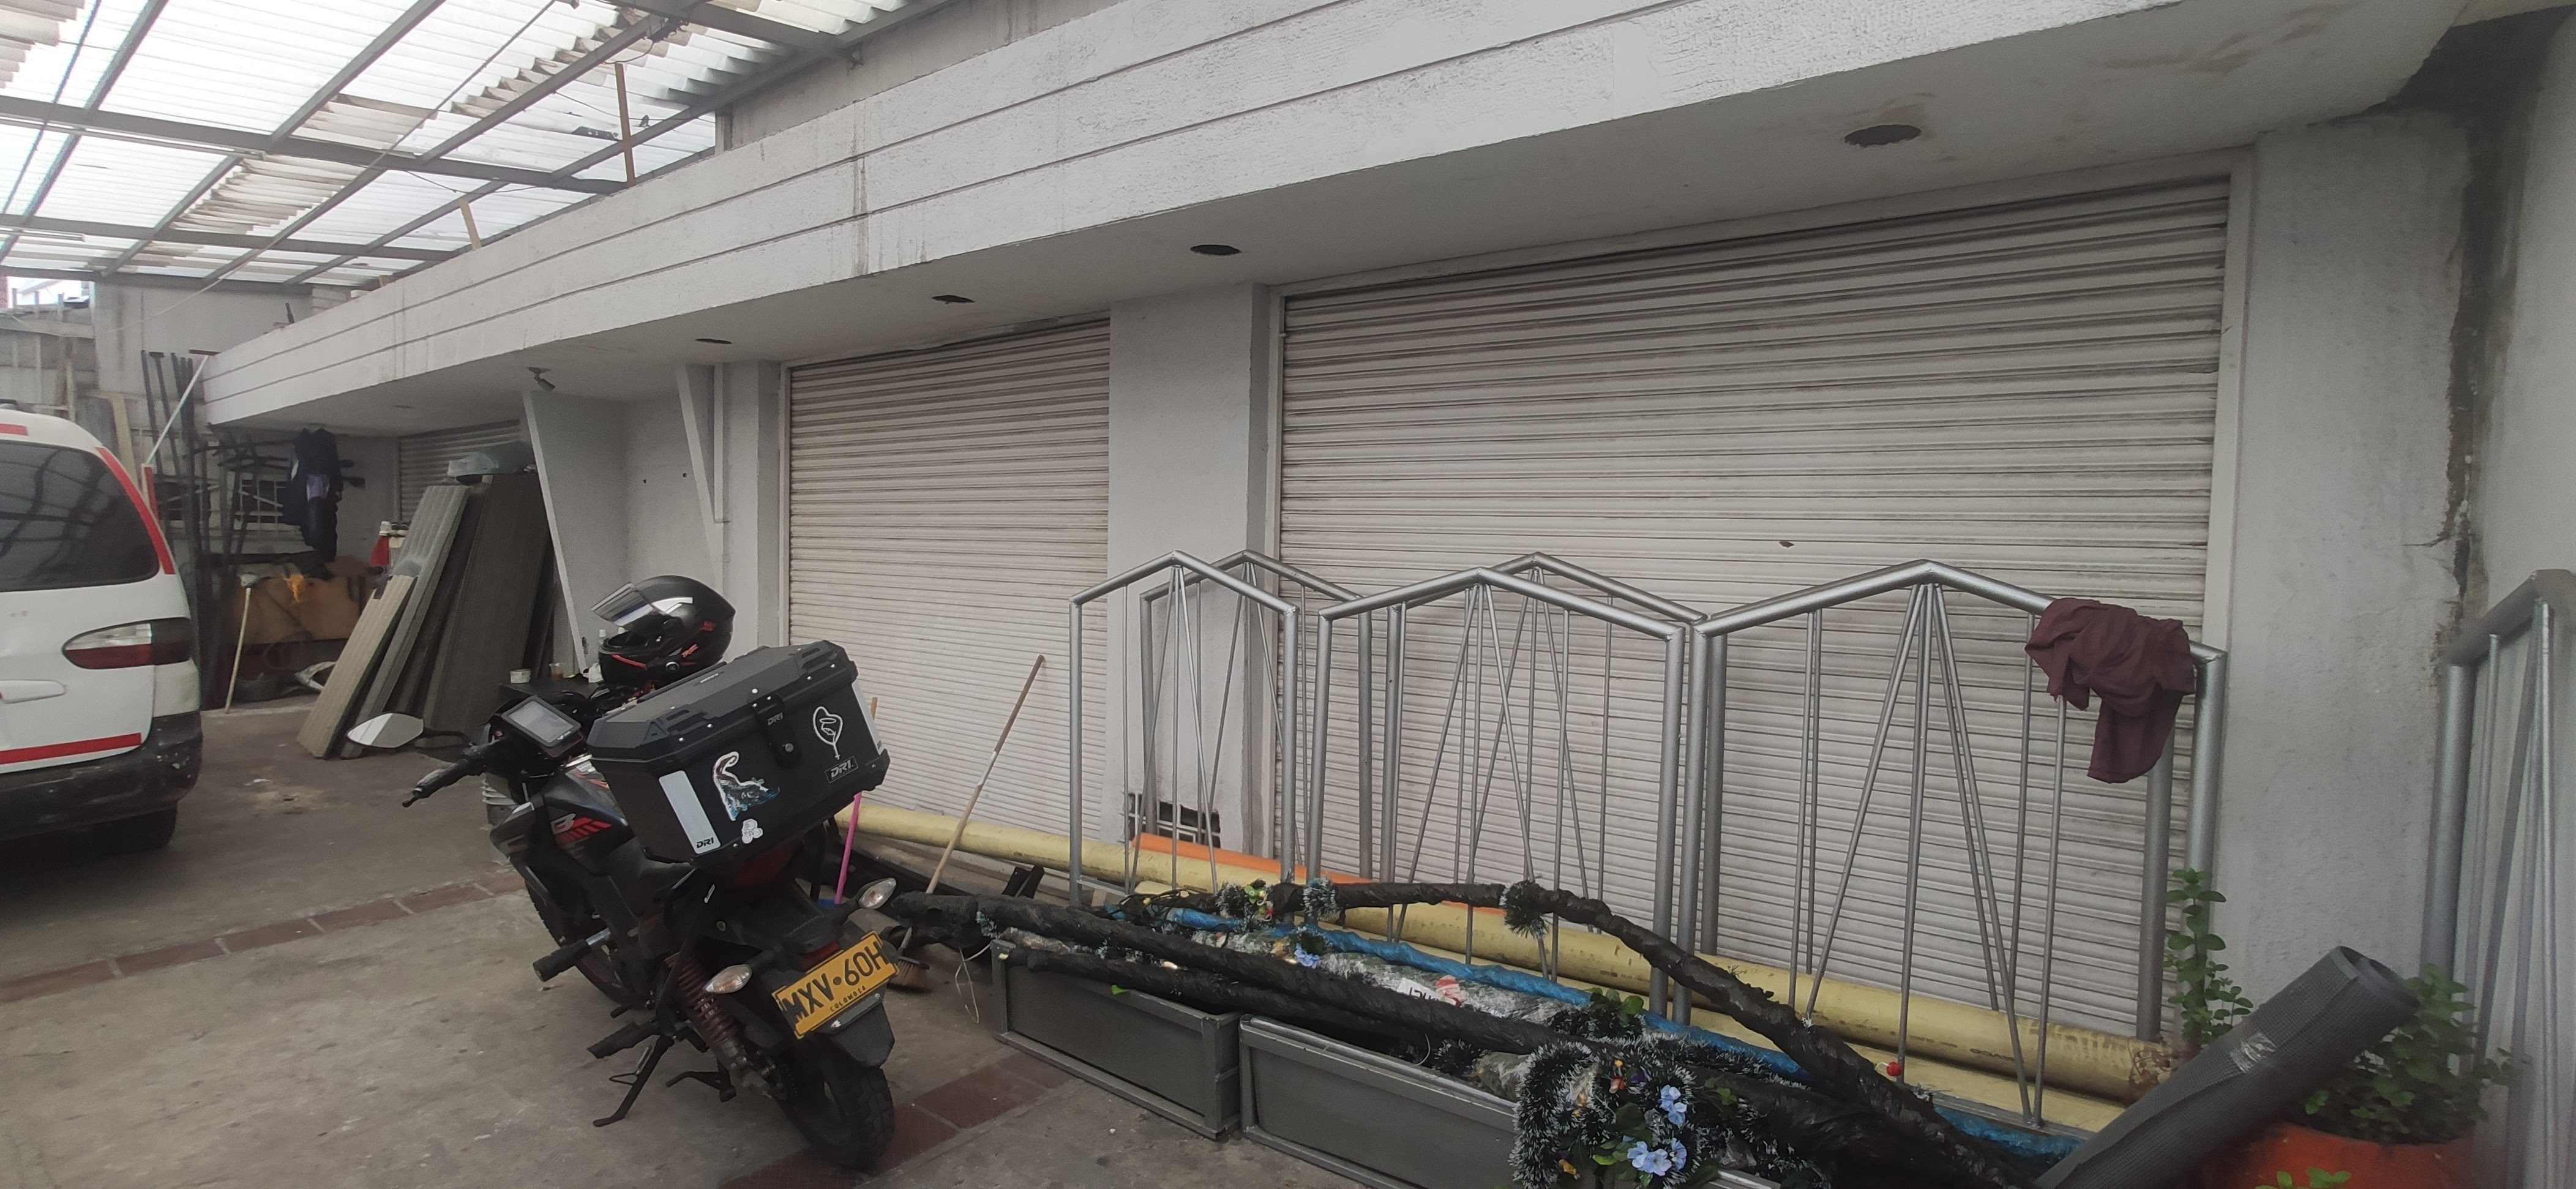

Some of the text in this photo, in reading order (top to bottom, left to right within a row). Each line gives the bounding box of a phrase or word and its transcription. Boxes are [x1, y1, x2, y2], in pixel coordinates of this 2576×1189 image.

[767, 712, 783, 726] DR1
[696, 837, 714, 849] DR1
[829, 985, 867, 1011] COLOMBIA
